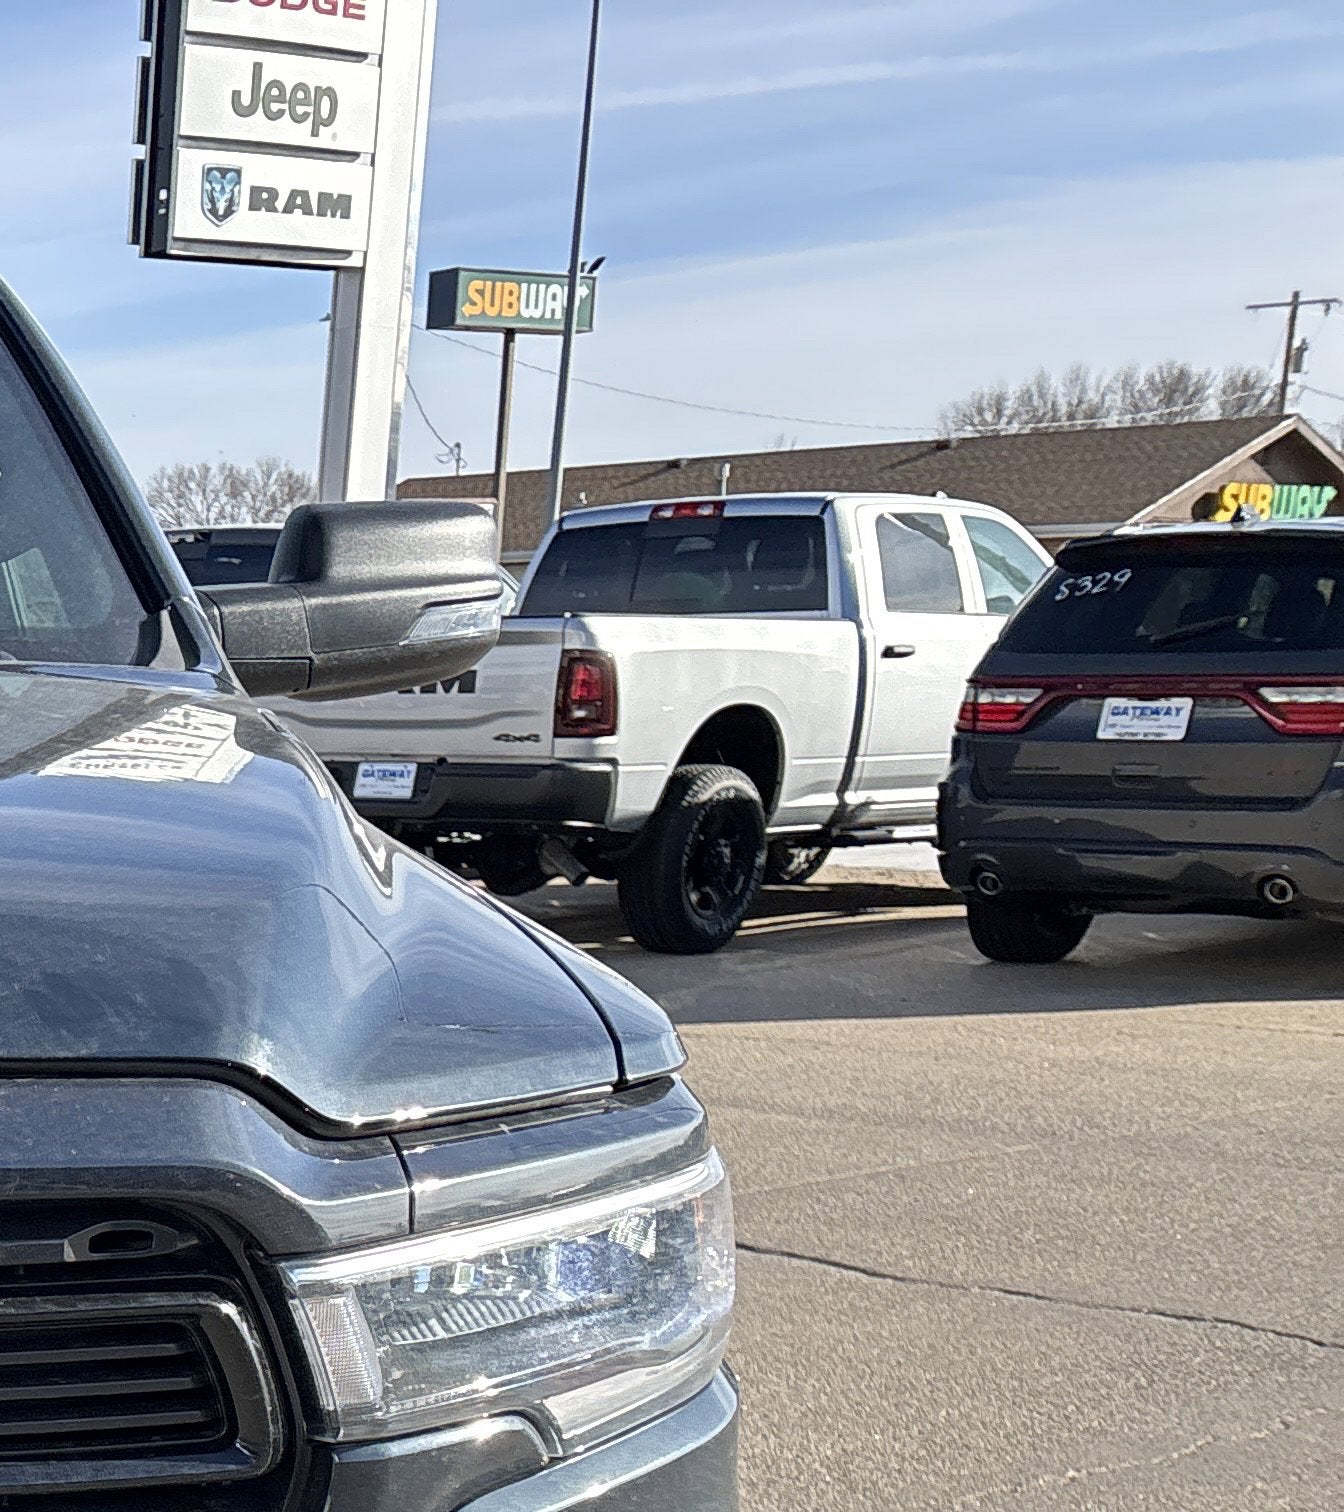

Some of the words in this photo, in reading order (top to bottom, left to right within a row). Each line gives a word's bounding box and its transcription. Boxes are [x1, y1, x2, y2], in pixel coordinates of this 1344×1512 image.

[231, 62, 338, 137] Jeep
[248, 185, 353, 219] RAM
[1111, 706, 1185, 717] GATEWAY
